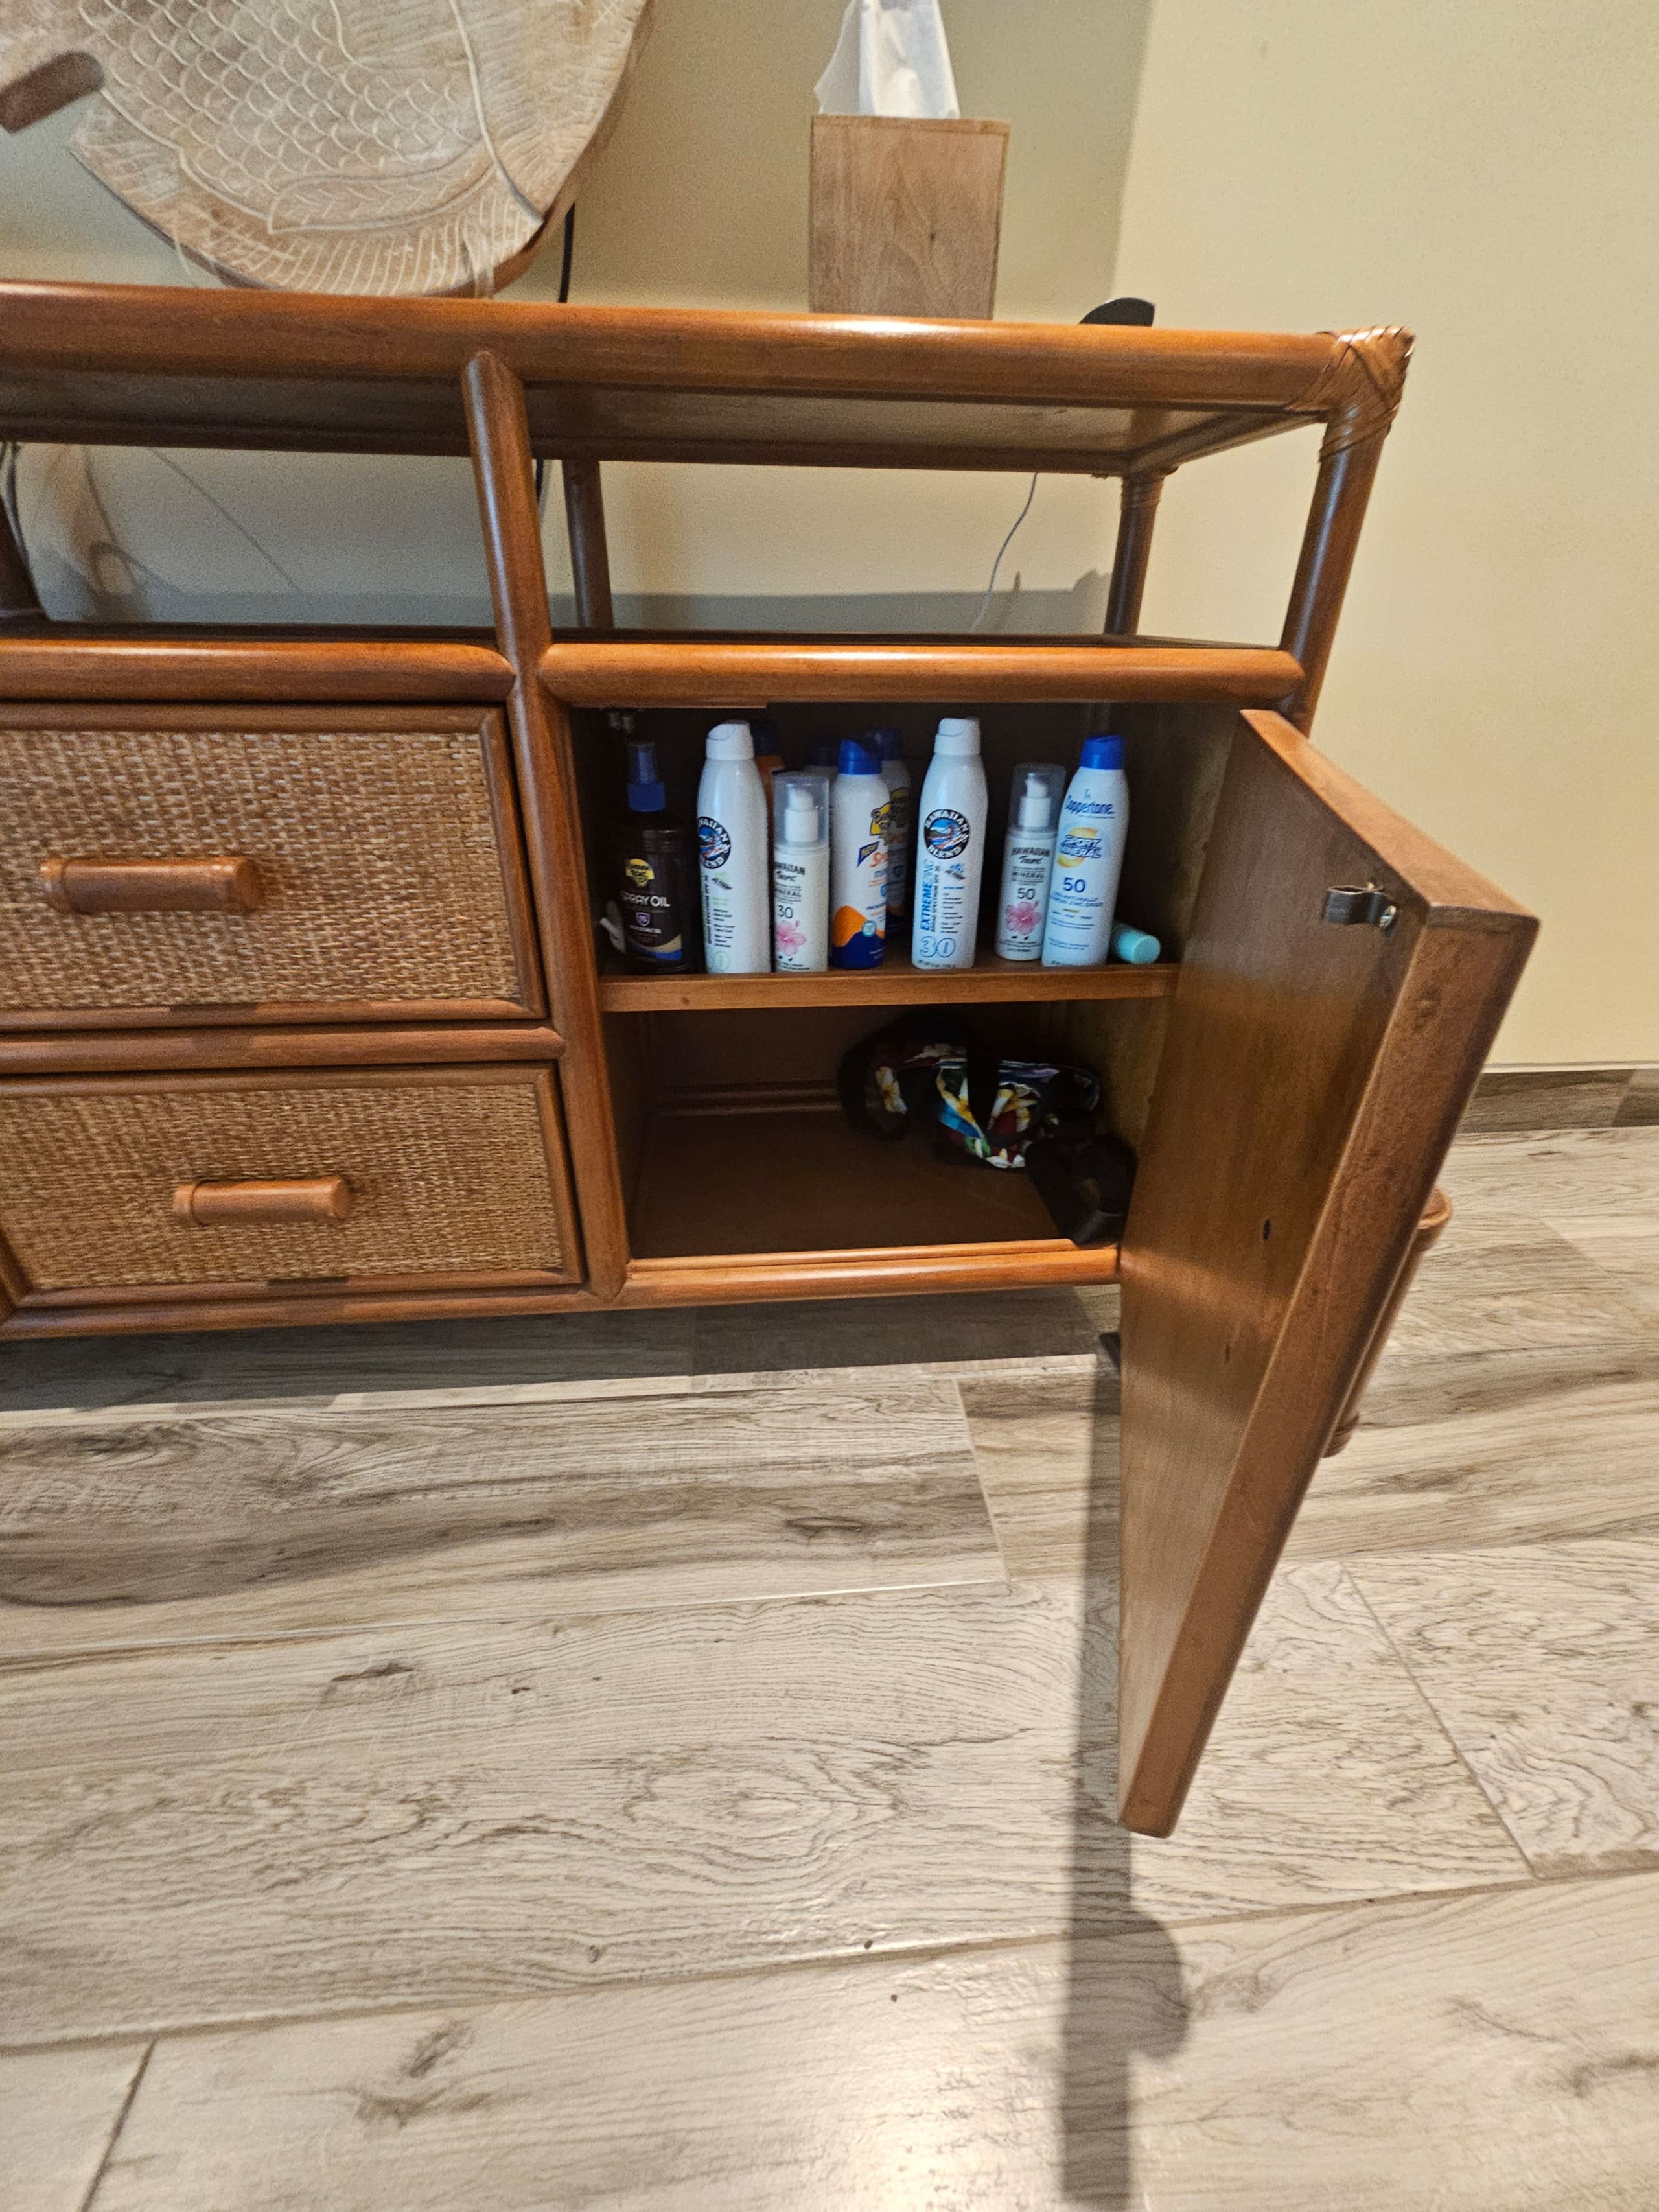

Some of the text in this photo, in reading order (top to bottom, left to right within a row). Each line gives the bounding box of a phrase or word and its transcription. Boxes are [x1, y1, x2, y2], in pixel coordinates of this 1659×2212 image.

[1064, 834, 1102, 848] SPORT
[1011, 847, 1050, 857] HAWAIIAN
[1060, 842, 1102, 859] MINERAL
[1063, 877, 1087, 893] 50
[621, 891, 671, 907] SPRAY OIL
[1017, 887, 1036, 900] 50
[778, 905, 793, 919] 30
[920, 881, 932, 931] EXTREME
